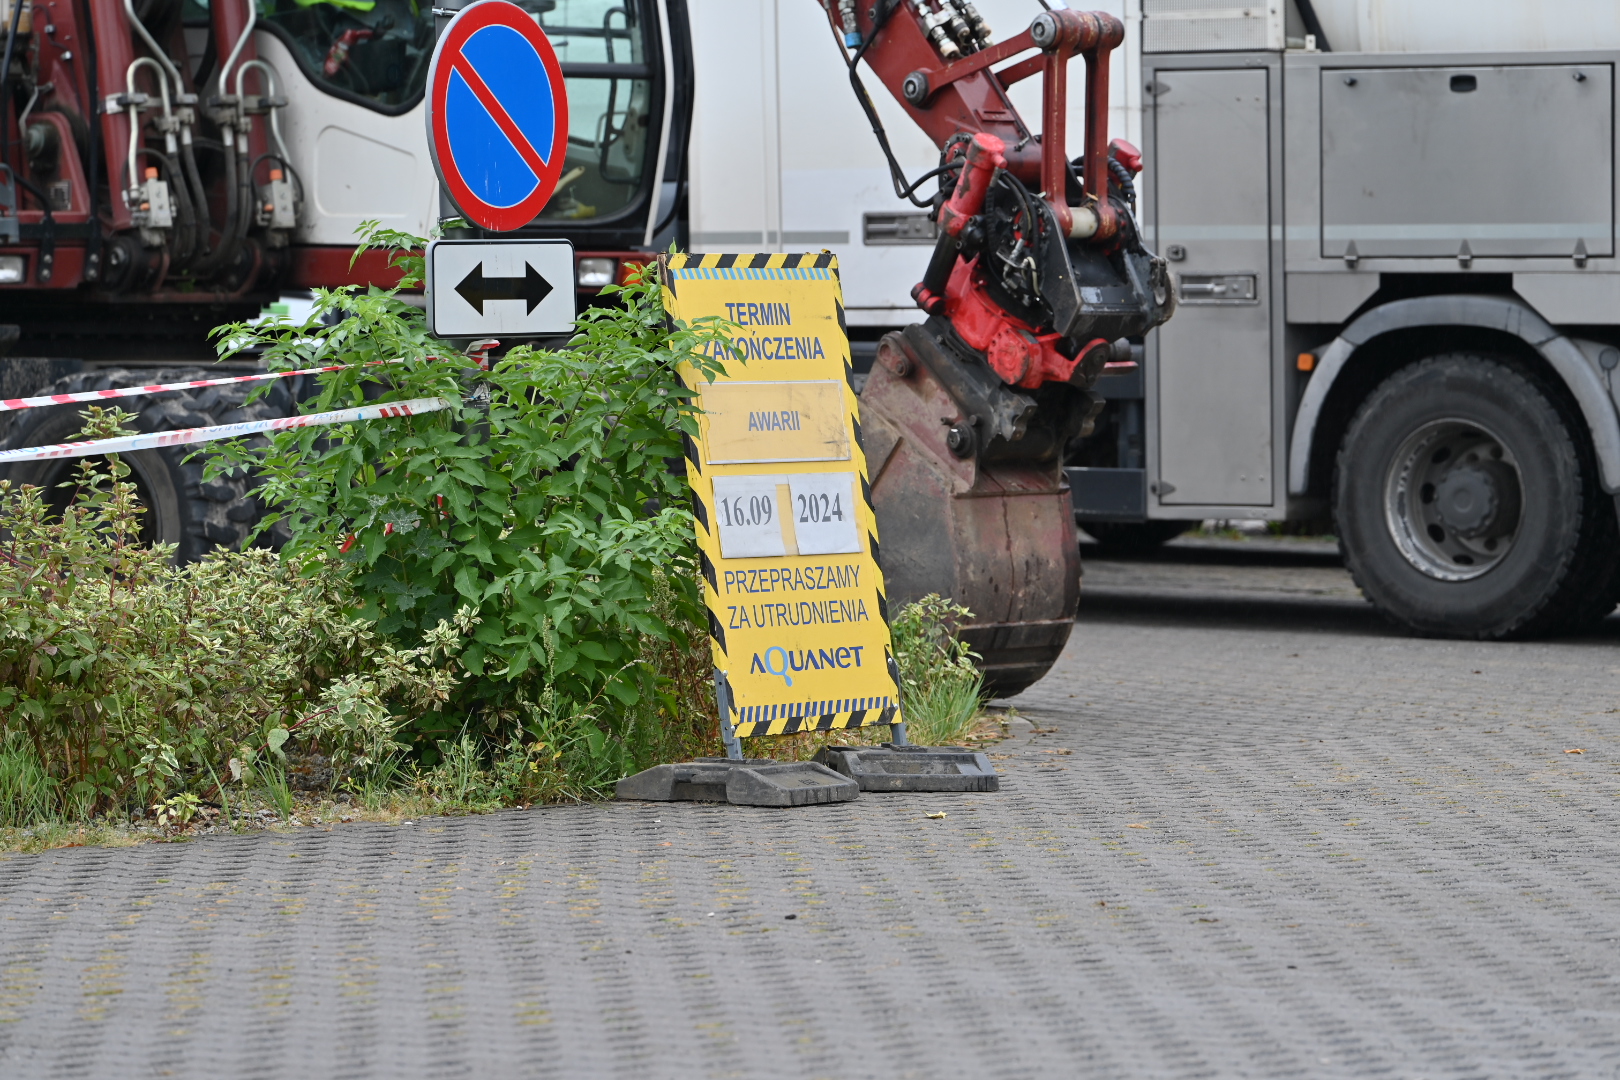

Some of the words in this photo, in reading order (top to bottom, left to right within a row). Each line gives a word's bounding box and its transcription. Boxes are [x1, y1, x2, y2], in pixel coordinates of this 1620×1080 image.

[725, 302, 791, 326] TERMIN
[748, 410, 801, 432] AWARII
[721, 494, 773, 527] 16.09
[797, 492, 844, 523] 2024
[724, 564, 860, 595] PRZEPRASZAMY
[727, 605, 752, 630] ZA
[753, 598, 869, 629] UTRUDNIENIA
